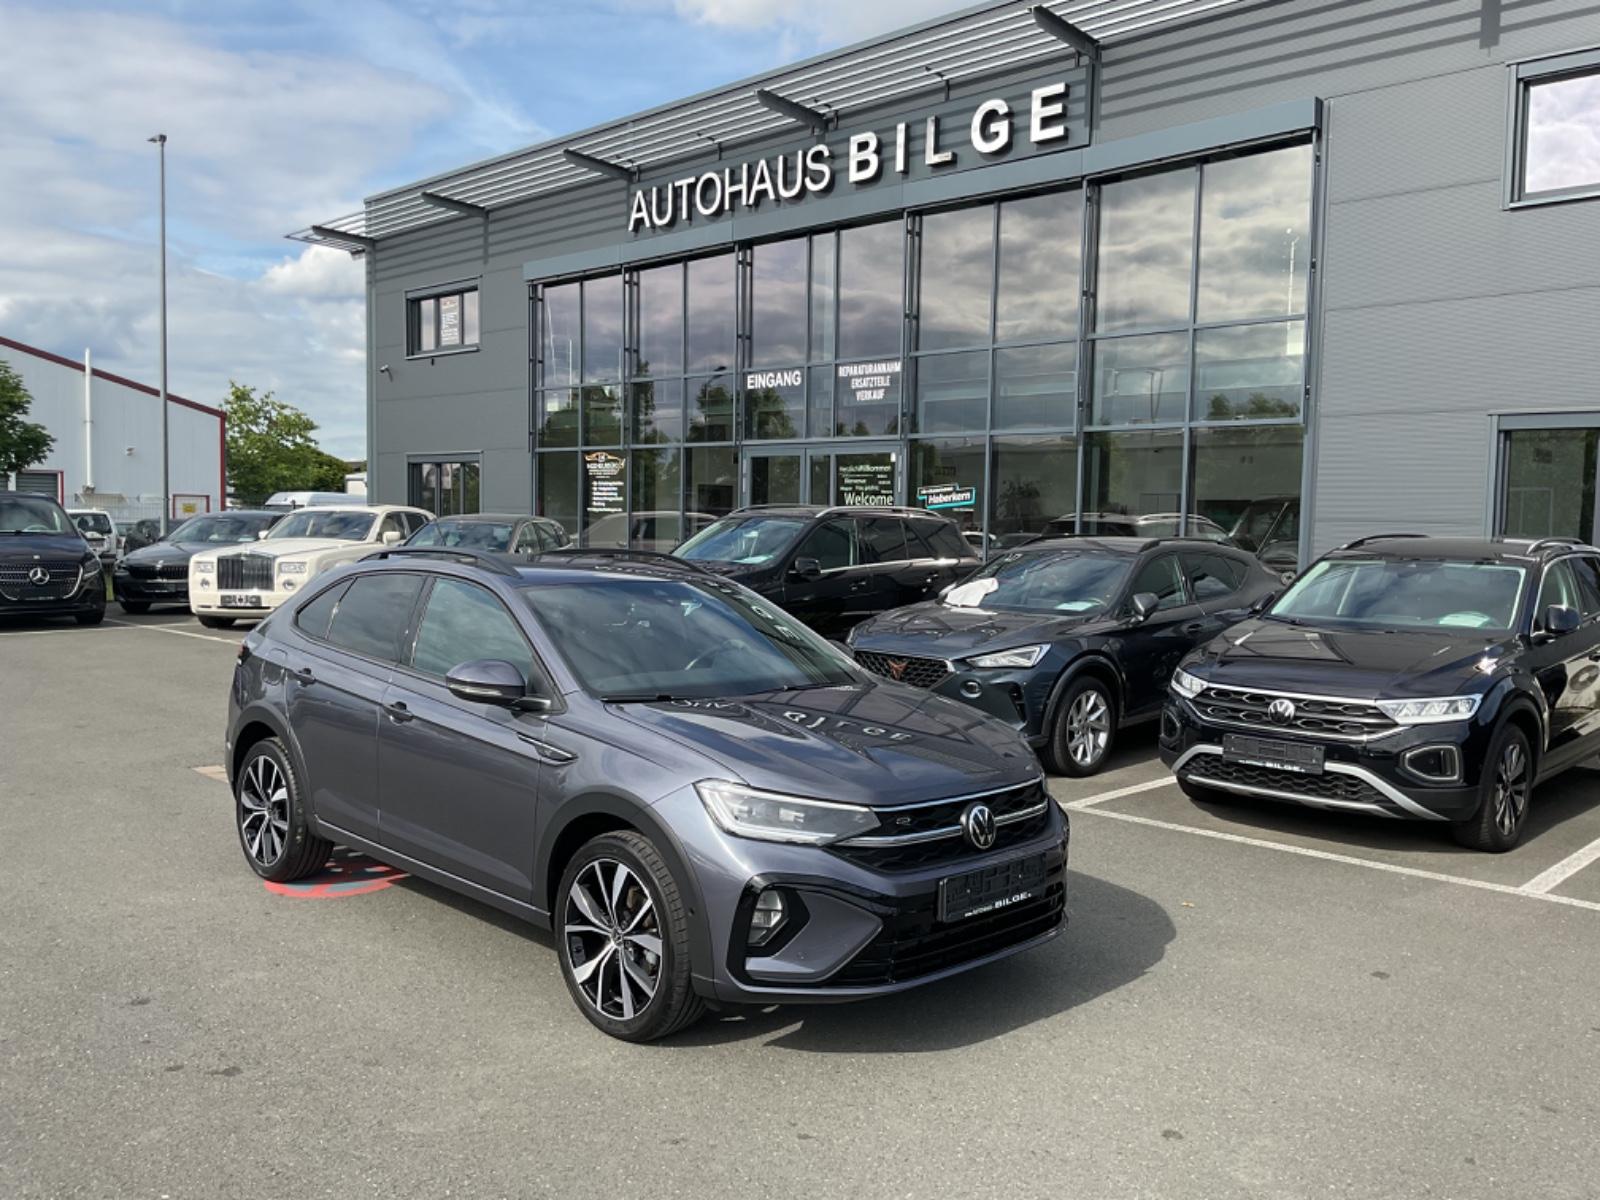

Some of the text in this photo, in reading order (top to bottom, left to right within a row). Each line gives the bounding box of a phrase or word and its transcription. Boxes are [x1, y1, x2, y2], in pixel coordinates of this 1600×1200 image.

[628, 82, 1070, 233] AUTOHAUS BILGE
[838, 361, 901, 376] REPARATURANNAHM
[747, 371, 801, 389] EINGANG
[851, 375, 891, 389] ERSATZTEILE
[856, 389, 885, 401] VERKAUF
[844, 492, 893, 505] Welcome
[929, 492, 971, 504] Haberkern
